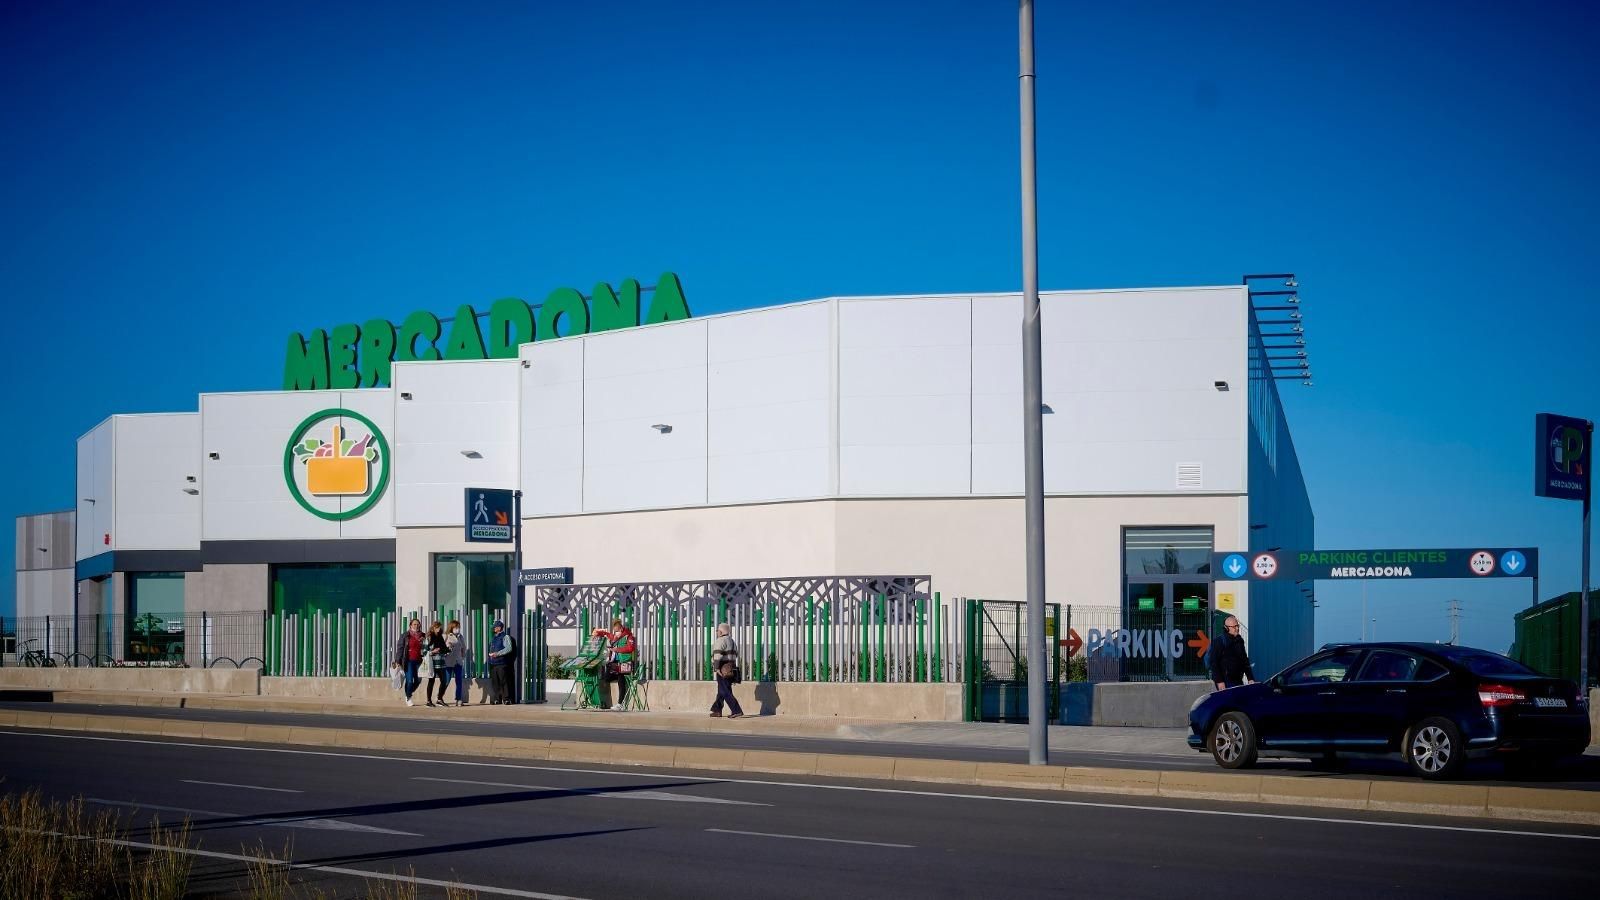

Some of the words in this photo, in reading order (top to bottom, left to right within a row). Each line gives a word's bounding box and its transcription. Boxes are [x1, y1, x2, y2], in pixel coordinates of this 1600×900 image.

[282, 271, 692, 391] MERCADONA
[1550, 480, 1582, 490] MERCADONA
[1299, 552, 1367, 564] PARKING
[1372, 551, 1447, 563] CLIENTES
[542, 572, 565, 580] PEATONAL
[1331, 566, 1412, 577] MERCADONA
[1087, 628, 1184, 659] PARKING
